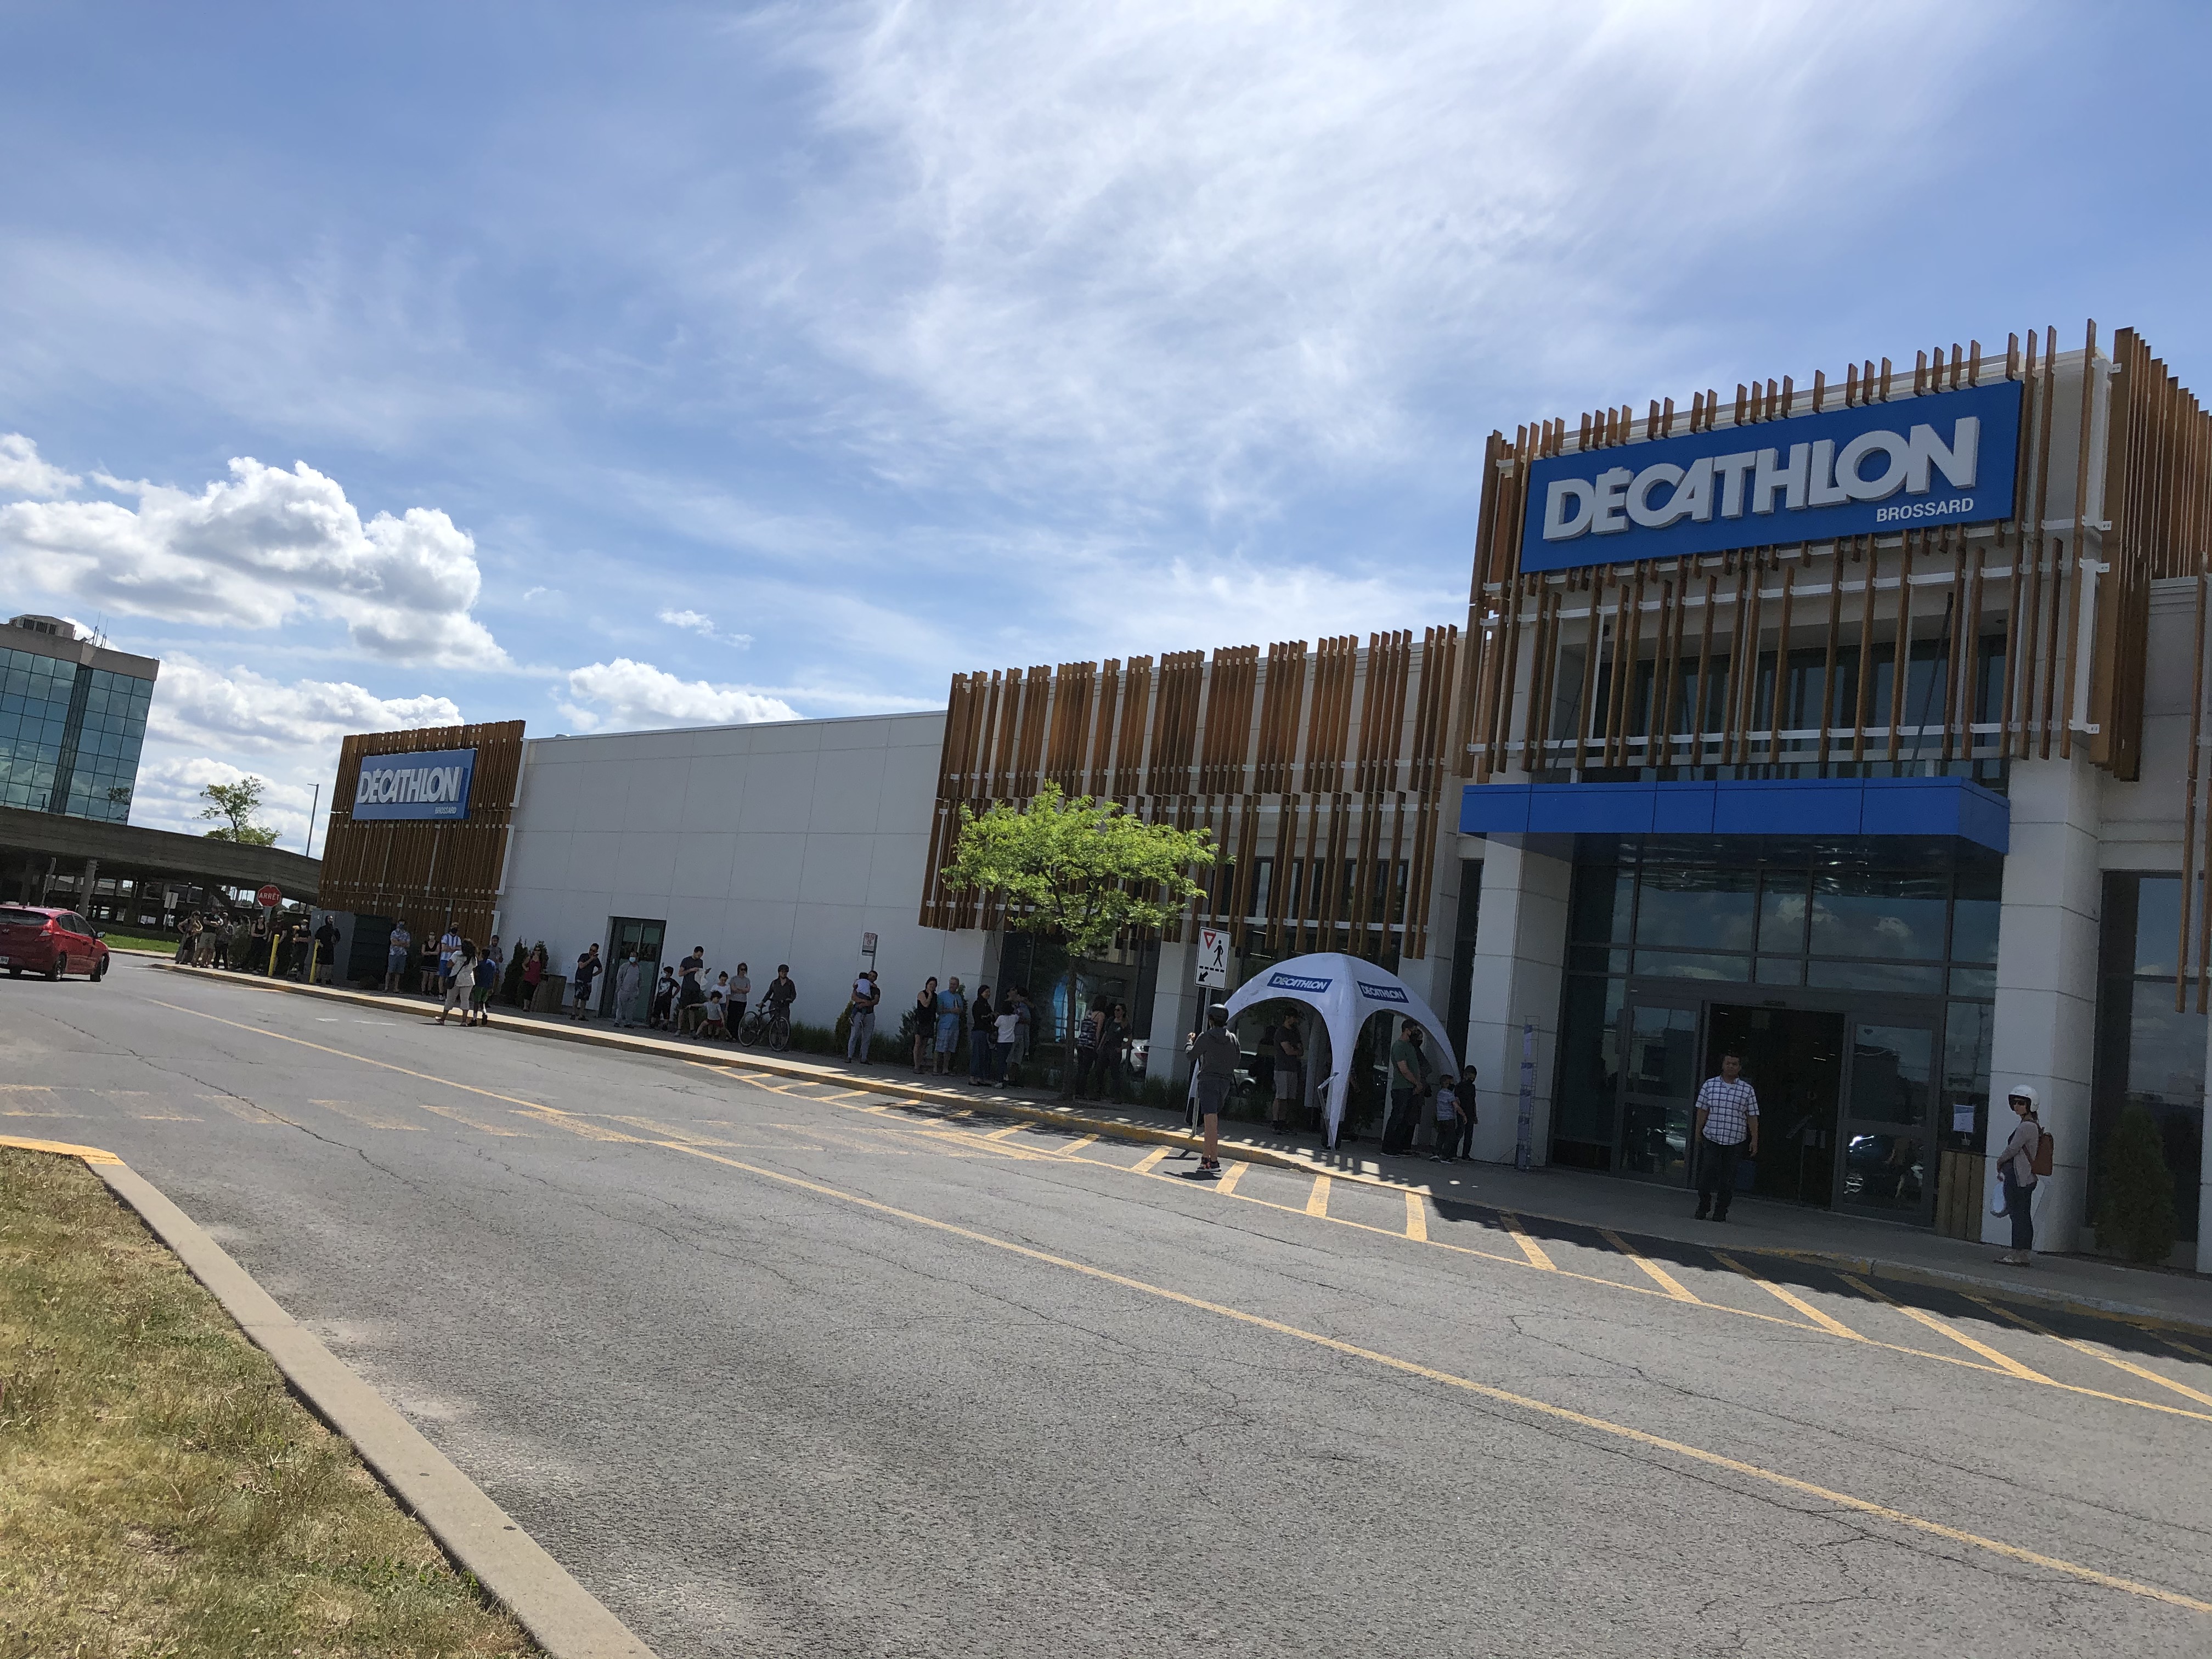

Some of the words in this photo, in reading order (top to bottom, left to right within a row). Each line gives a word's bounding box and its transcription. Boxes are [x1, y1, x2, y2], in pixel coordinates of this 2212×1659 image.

[1876, 498, 1974, 522] BROSSARD
[259, 892, 280, 901] ARRÊT
[1272, 976, 1327, 989] DECATHLON
[1361, 985, 1404, 1000] DECATHLON
